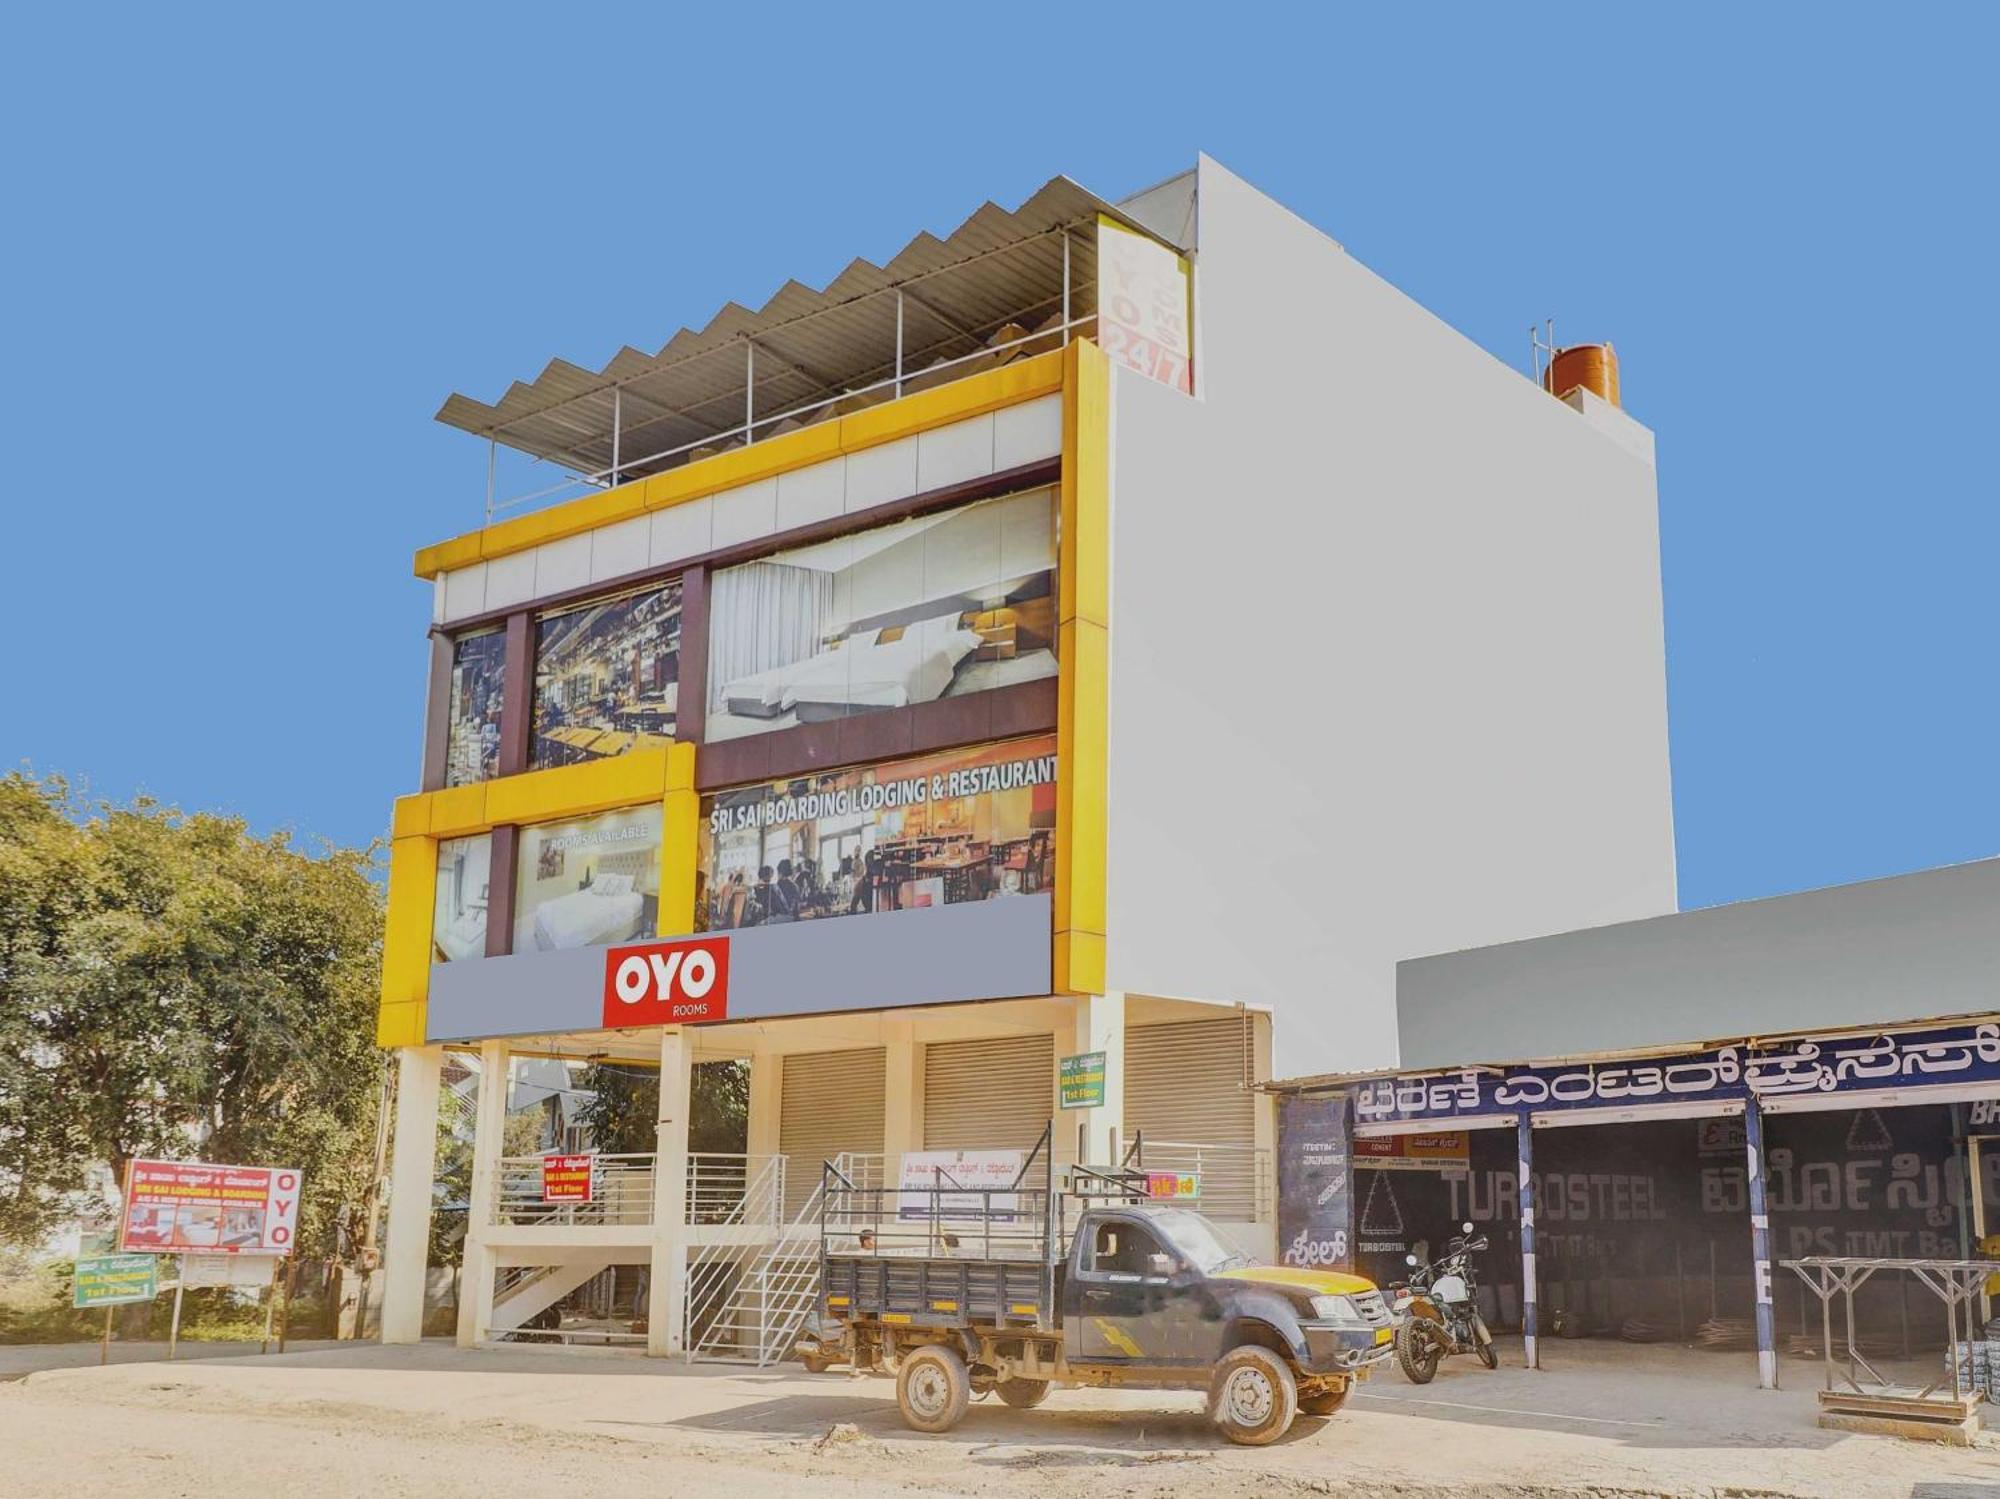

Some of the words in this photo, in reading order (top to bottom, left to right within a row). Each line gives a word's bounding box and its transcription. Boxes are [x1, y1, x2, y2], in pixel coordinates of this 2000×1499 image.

[710, 807, 733, 835] SRI
[736, 803, 763, 831] SAI
[764, 793, 849, 828] BOARDING
[852, 778, 926, 813] LODGING
[931, 777, 944, 799] &
[590, 823, 650, 846] AVAILABLE
[615, 949, 716, 1004] OYO
[672, 1003, 708, 1017] ROOMS
[1079, 1087, 1099, 1098] Floor
[1440, 1169, 1667, 1222] TURBOSTEEL
